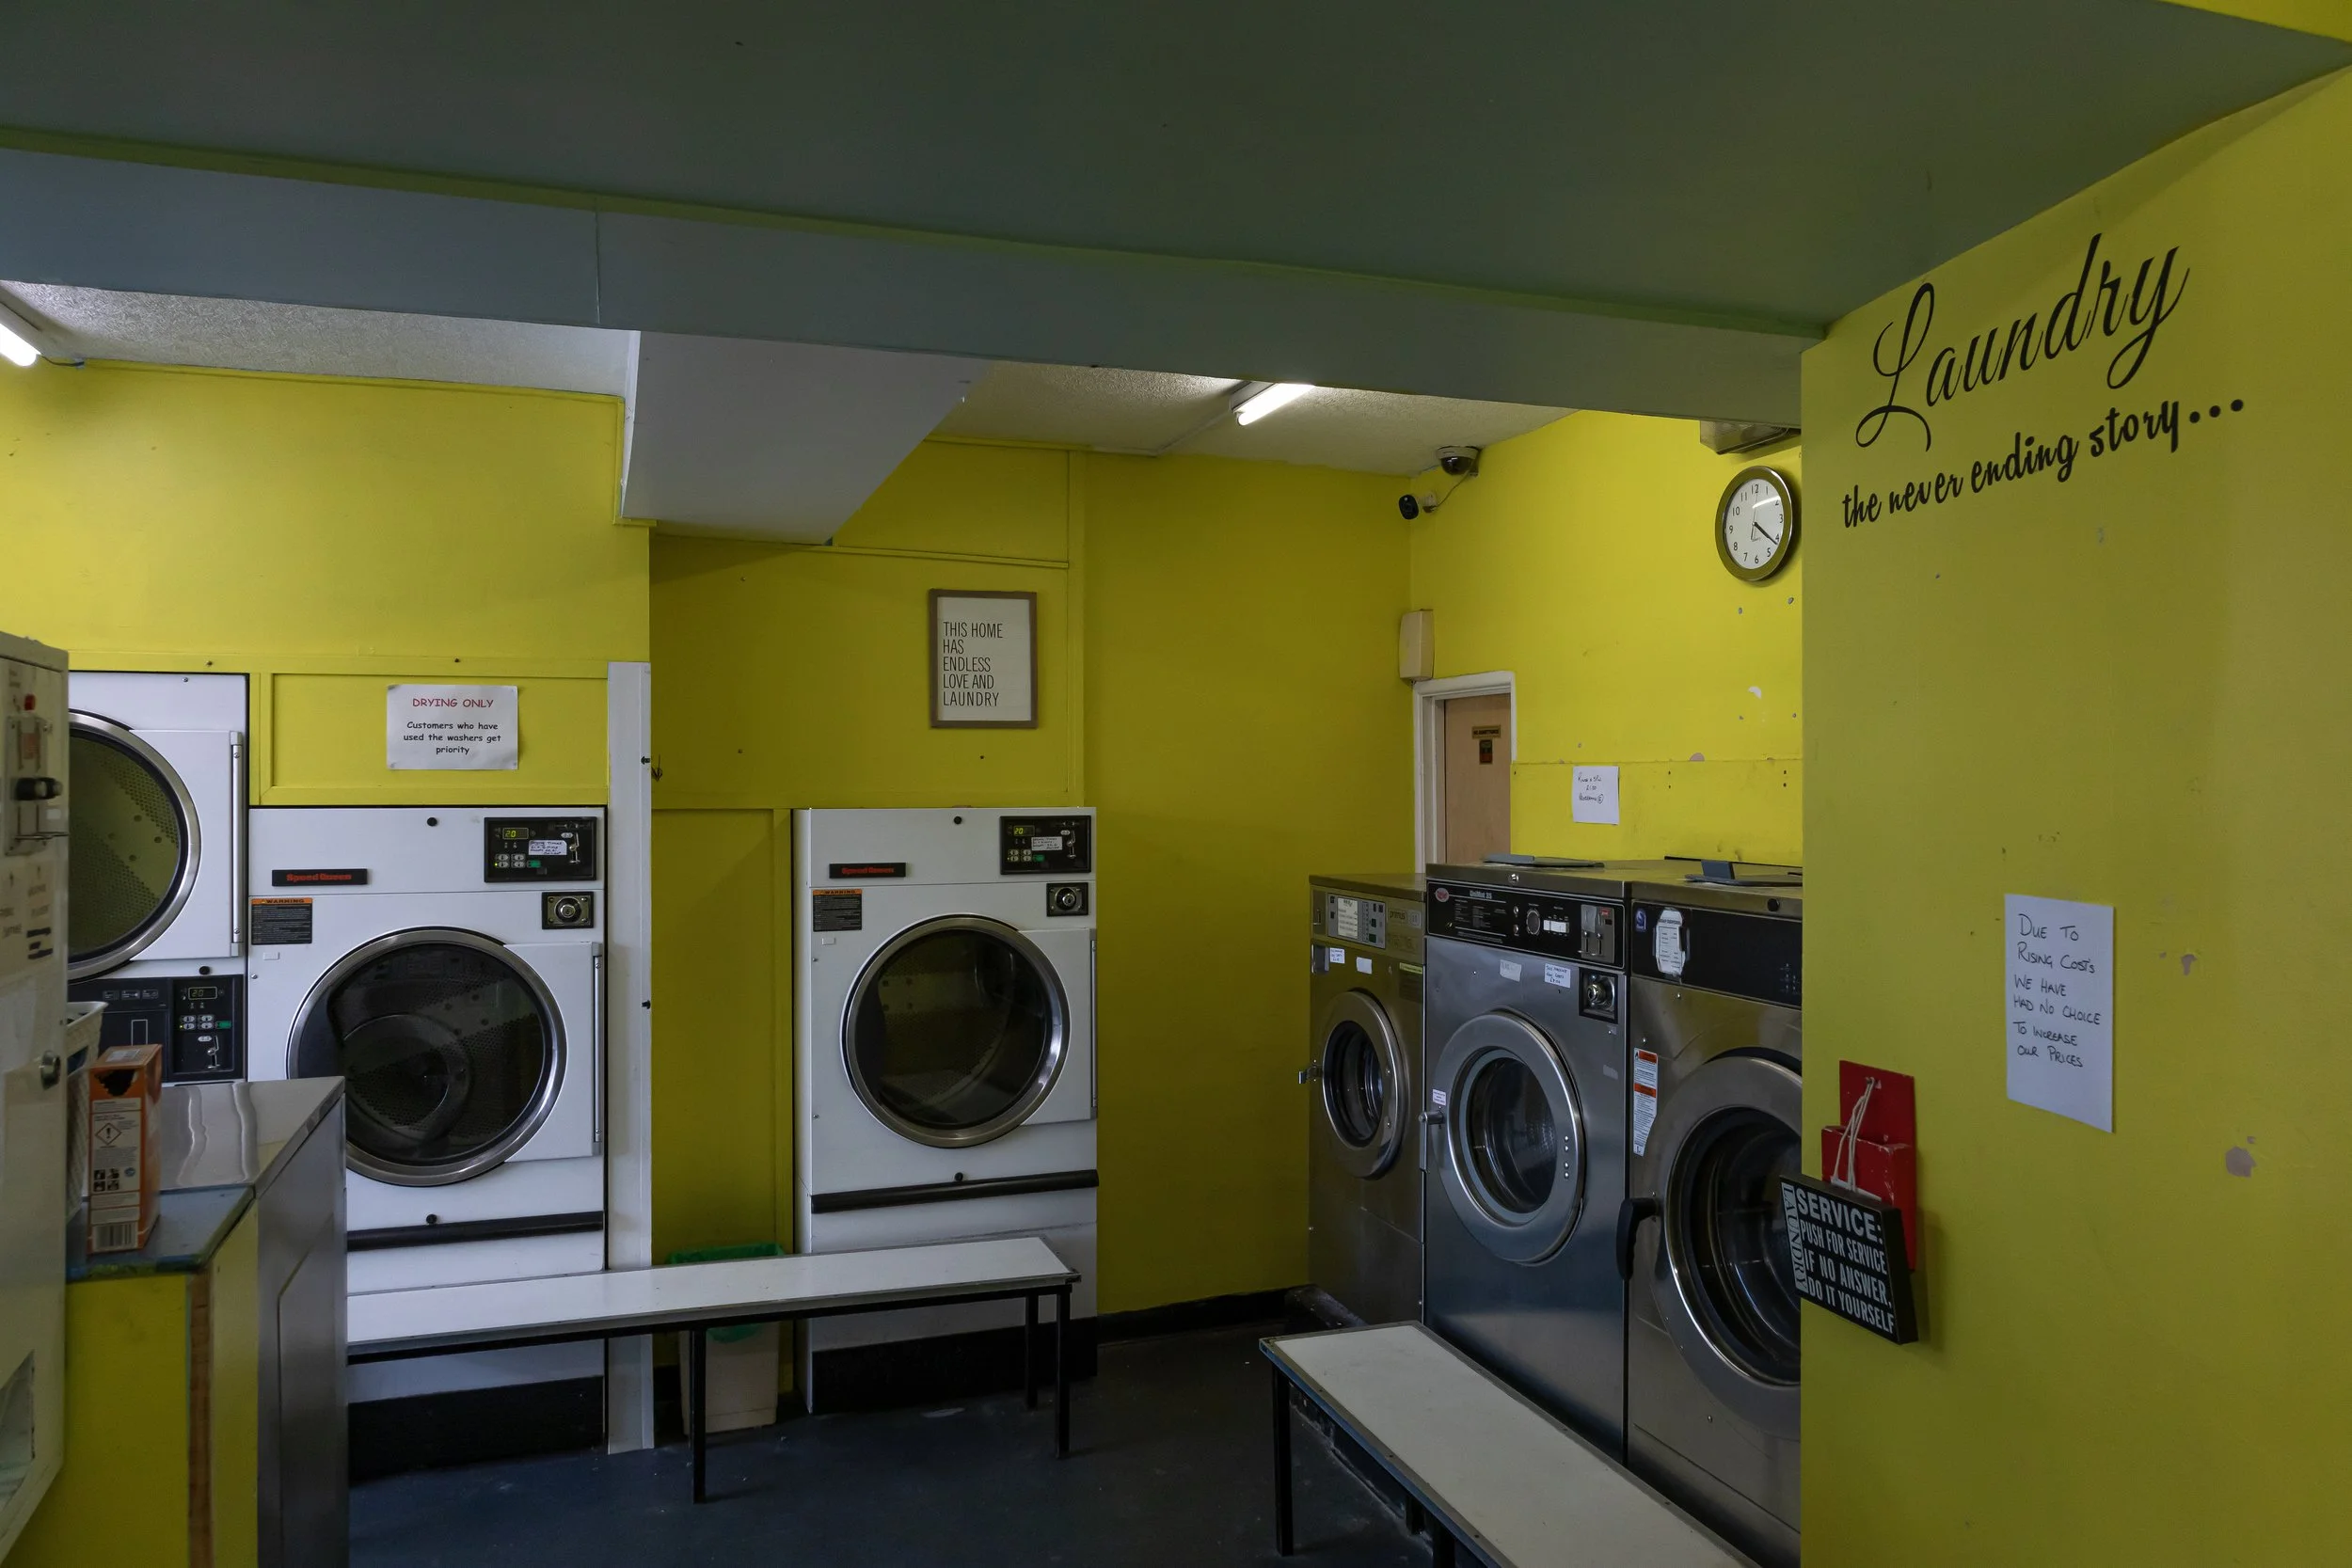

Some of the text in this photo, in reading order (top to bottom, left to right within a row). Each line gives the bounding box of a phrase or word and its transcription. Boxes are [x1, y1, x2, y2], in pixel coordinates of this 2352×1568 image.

[1855, 232, 2190, 451] Laundry
[1842, 484, 1882, 528] the
[1889, 472, 1963, 514] never
[1971, 432, 2079, 483] ending
[1740, 492, 1748, 502] 11
[1751, 483, 1759, 495] 12
[1732, 506, 1740, 516] 10
[1779, 514, 1784, 524] 3
[1729, 525, 1733, 534] 9
[1733, 542, 1738, 550] 8
[1767, 547, 1772, 558] 5
[1743, 552, 1748, 562] 7
[1755, 555, 1759, 564] 6
[943, 621, 1004, 639] THIS HOME
[943, 639, 964, 655] HAS
[943, 657, 991, 673] ENDLESS
[943, 673, 994, 689] LOVE AND
[412, 698, 494, 708] DRYING ONLY
[943, 691, 999, 706] LAUNDRY
[406, 721, 453, 730] Customers
[447, 734, 483, 742] washers
[486, 735, 501, 743] get
[436, 746, 469, 755] priority
[504, 830, 516, 838] 20
[2018, 913, 2079, 942] DUE TO
[2017, 941, 2053, 969] RISING
[191, 989, 204, 997] 20
[2014, 974, 2066, 996] WE HAVE
[2013, 994, 2101, 1025] HAD NO CHOICE
[2012, 1022, 2077, 1046] TO INCREASE
[2017, 1045, 2083, 1068] OUR PRICES
[1796, 1188, 1883, 1244] SERVICE:
[1783, 1185, 1807, 1291] LAUNDRY
[1800, 1219, 1887, 1275] PUSH FOR SERVICE
[1804, 1248, 1892, 1307] IF NO ANSWER,
[1807, 1275, 1894, 1334] DO IT YOURSELF
